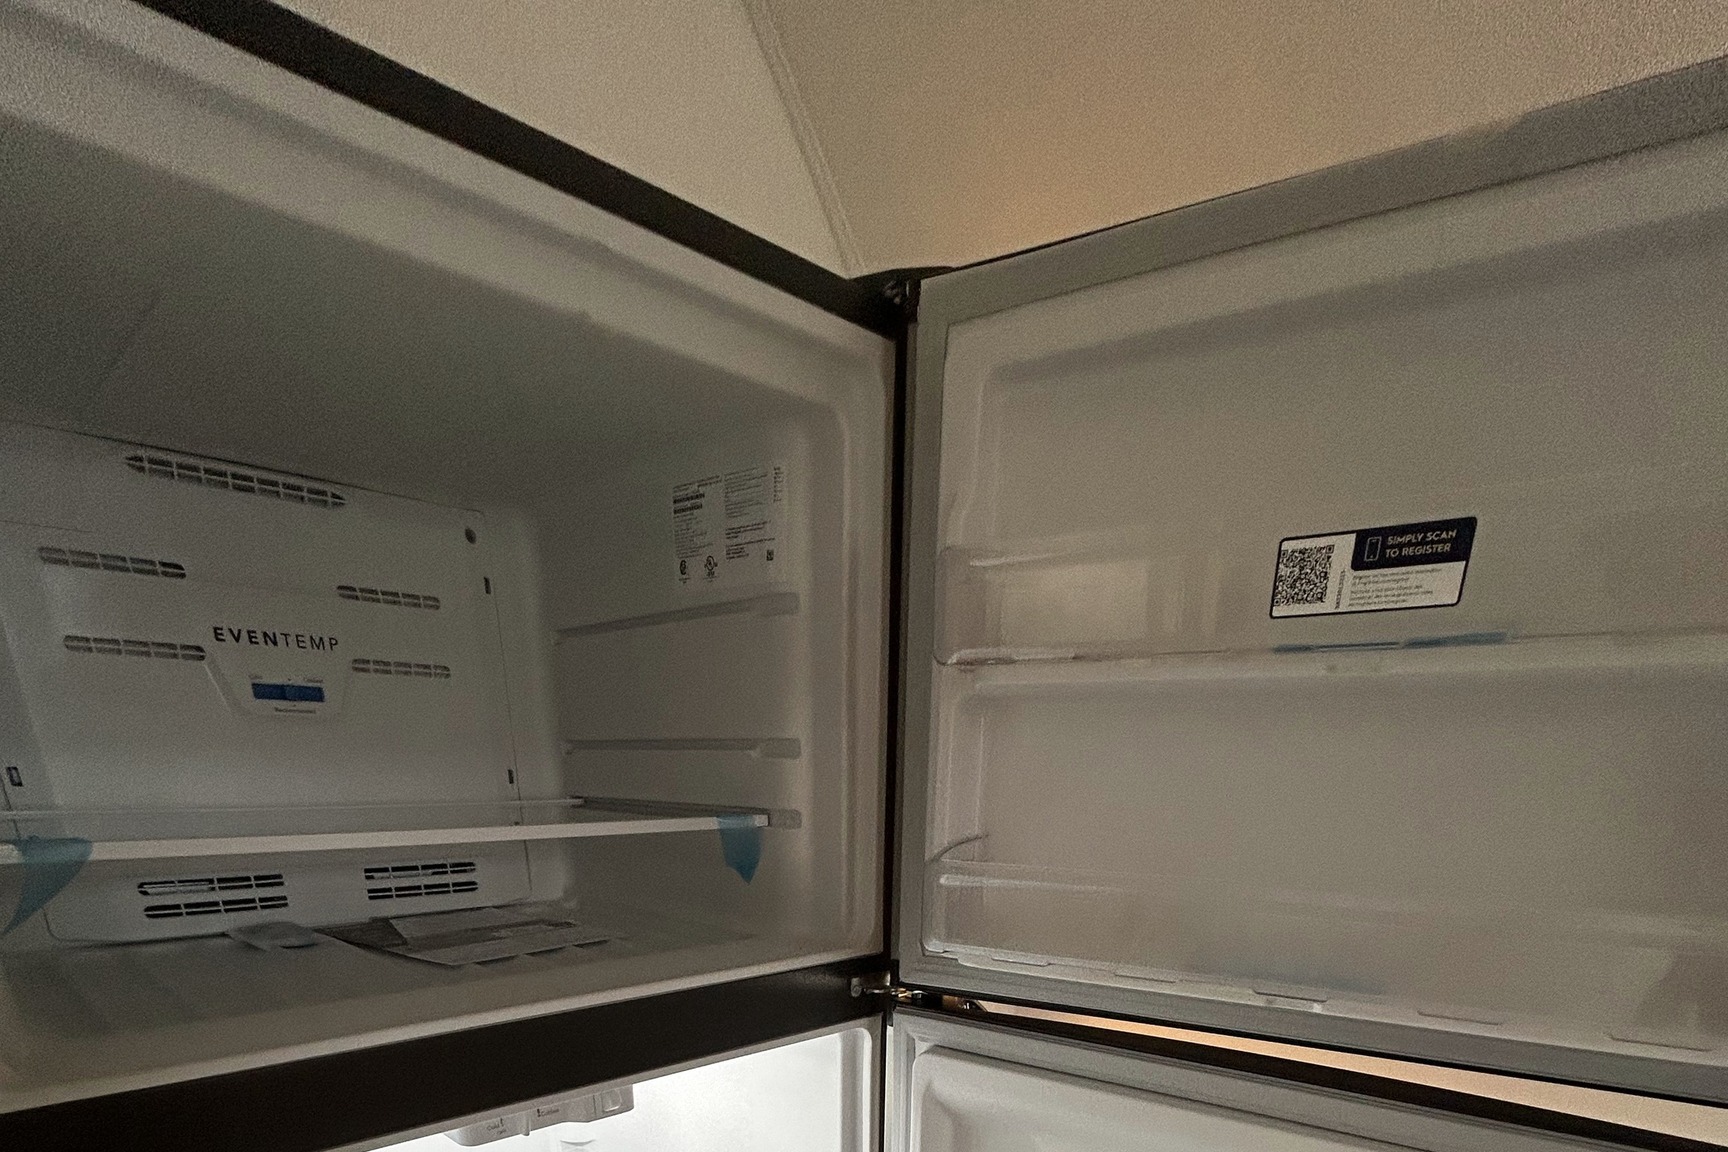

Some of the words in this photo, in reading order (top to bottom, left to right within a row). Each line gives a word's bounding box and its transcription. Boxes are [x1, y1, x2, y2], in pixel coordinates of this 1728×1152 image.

[1386, 533, 1423, 546] SIMPLY
[1425, 529, 1457, 541] SCAN
[1386, 548, 1400, 559] TO
[1401, 543, 1451, 557] REGISTER
[213, 626, 338, 651] EVENTEMP
